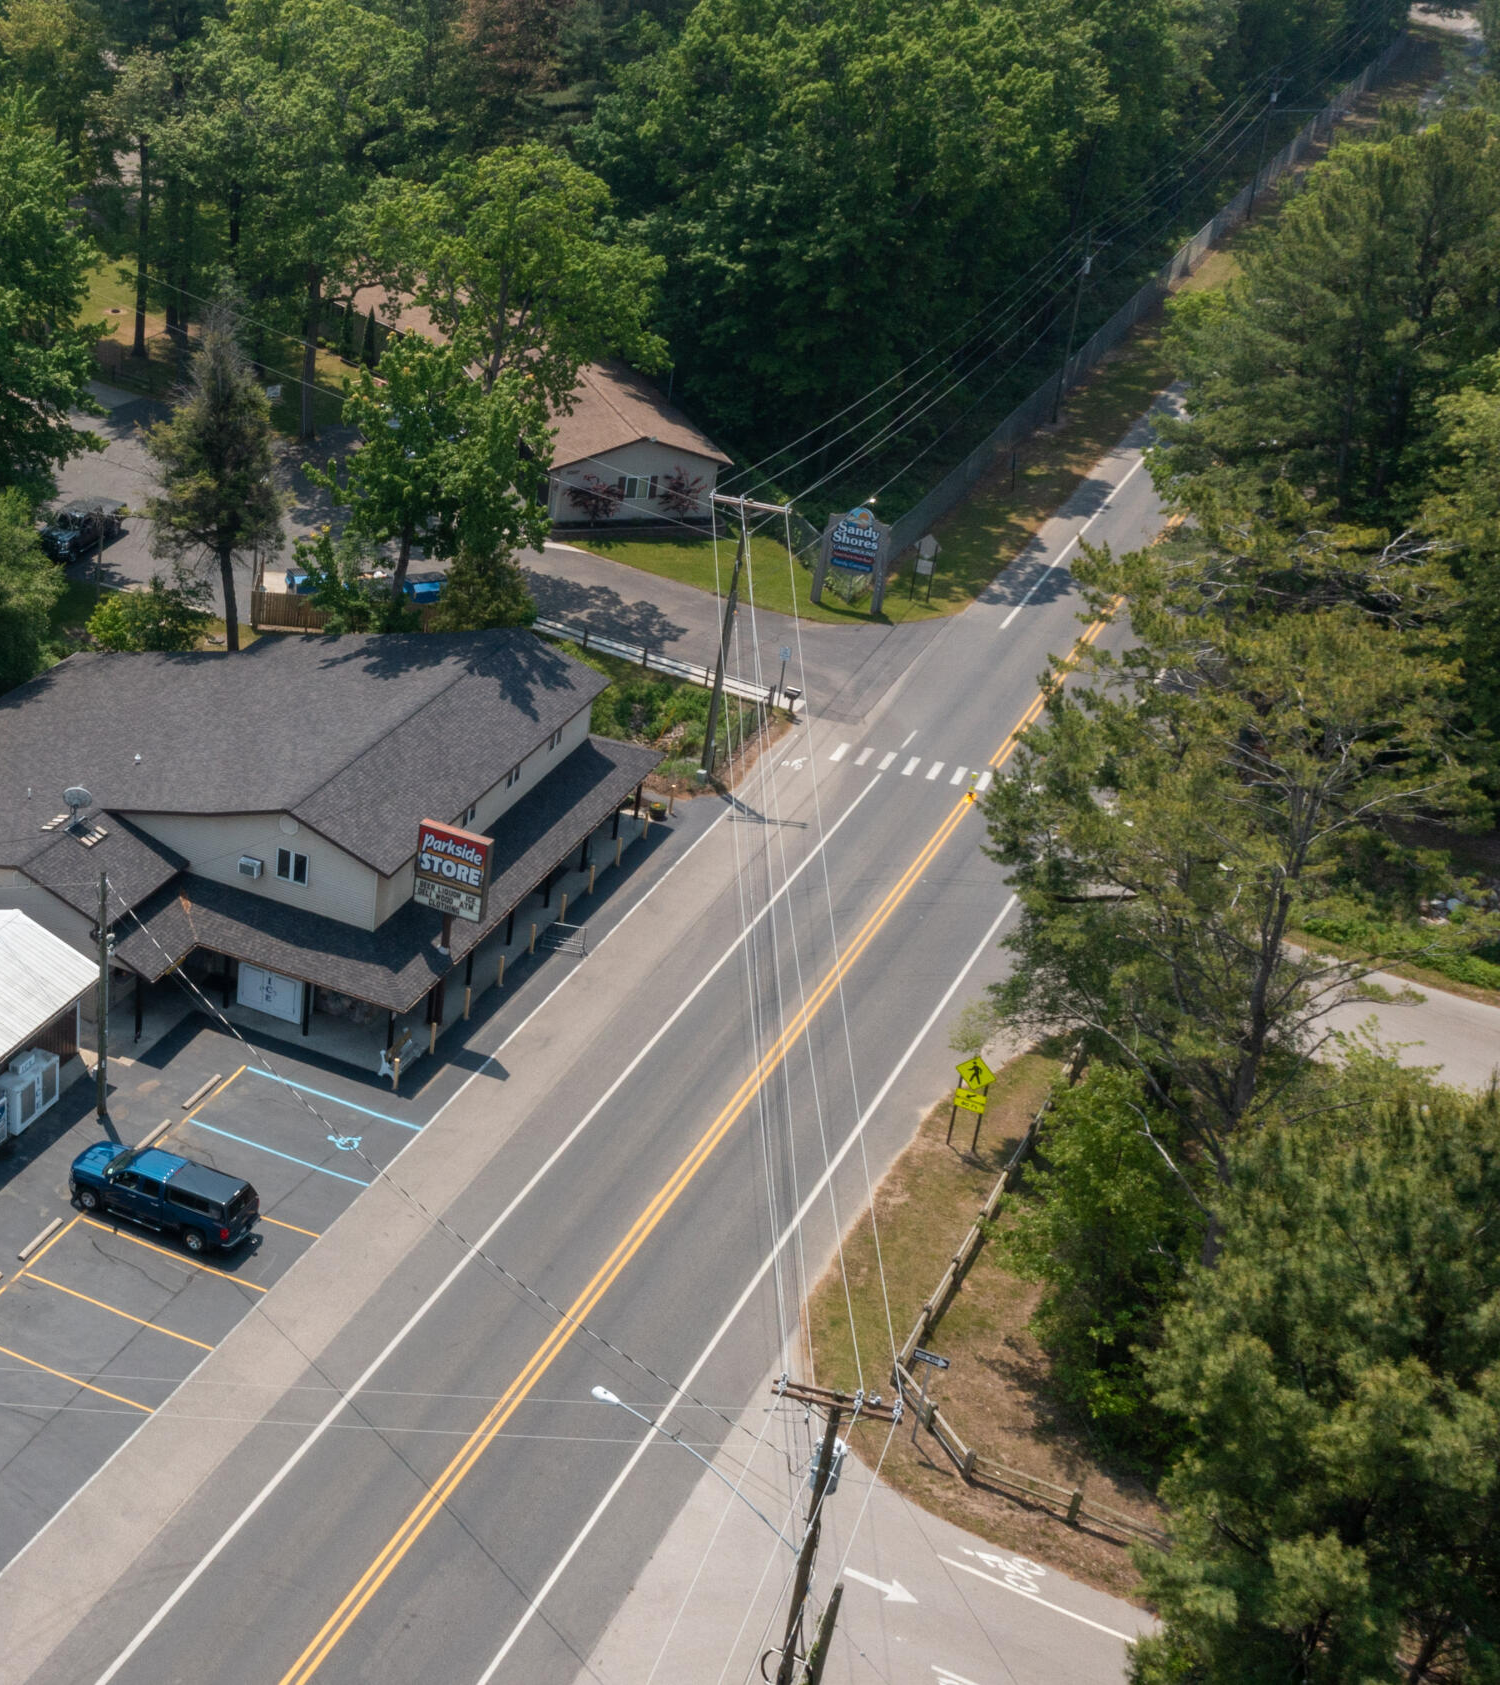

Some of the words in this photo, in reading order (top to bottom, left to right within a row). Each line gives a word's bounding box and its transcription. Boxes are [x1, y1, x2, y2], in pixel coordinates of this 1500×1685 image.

[832, 530, 878, 550] Shores
[838, 520, 880, 540] Sandy
[421, 832, 483, 866] Parkside
[420, 852, 482, 887] STORE
[265, 976, 273, 1002] ICE
